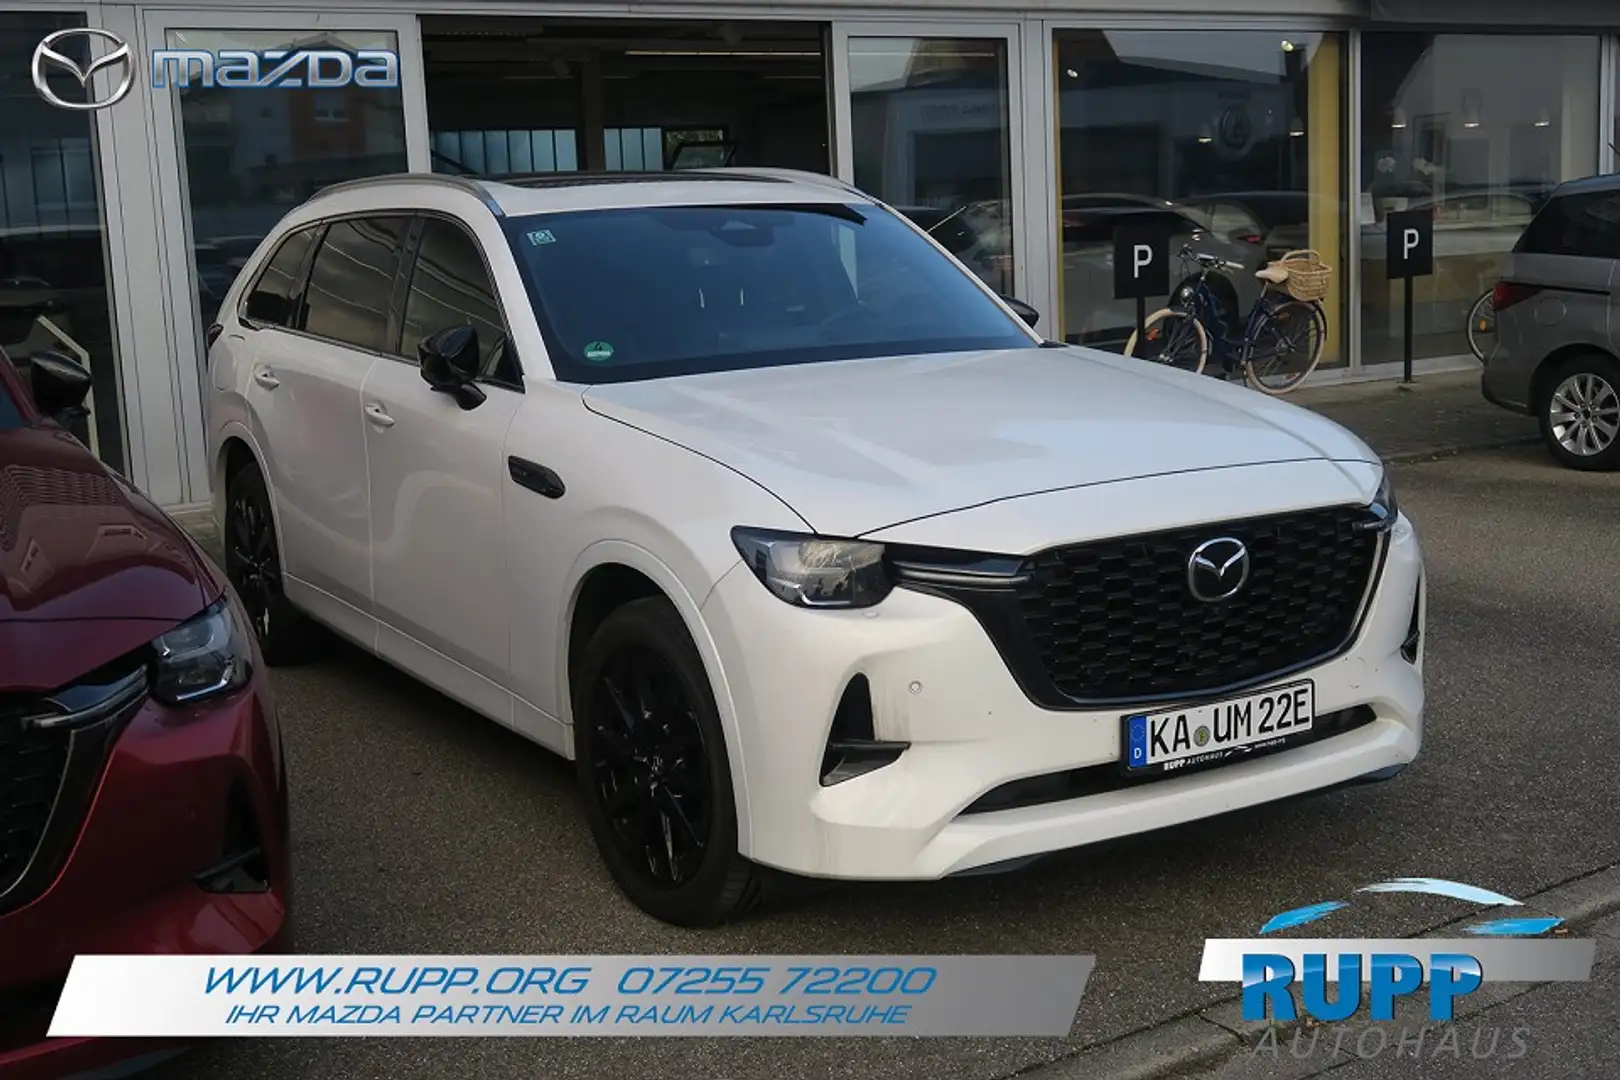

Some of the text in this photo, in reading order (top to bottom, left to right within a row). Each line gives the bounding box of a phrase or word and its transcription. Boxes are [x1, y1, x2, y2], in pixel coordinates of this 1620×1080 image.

[1401, 228, 1419, 259] P
[1133, 244, 1153, 278] P
[1150, 688, 1310, 757] KA UM 22E
[1133, 747, 1142, 759] D
[1163, 759, 1186, 771] RUPP
